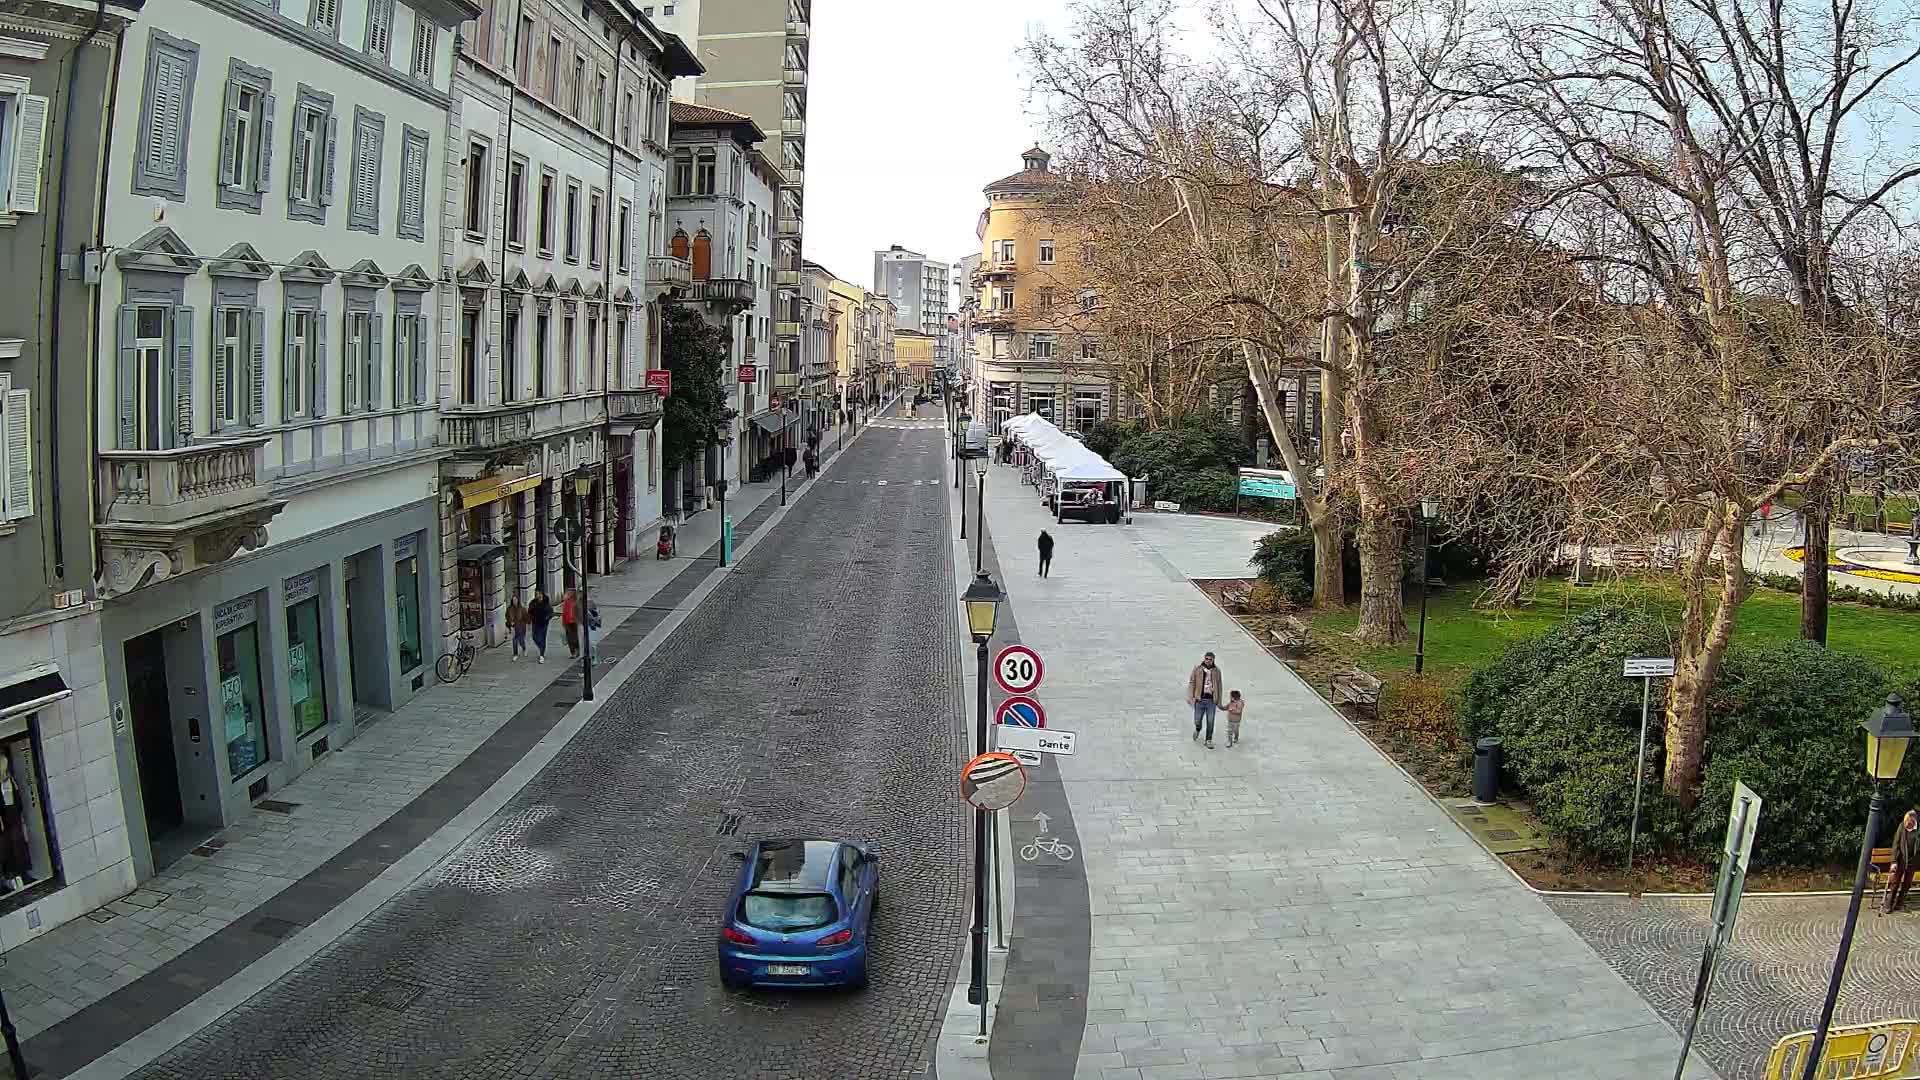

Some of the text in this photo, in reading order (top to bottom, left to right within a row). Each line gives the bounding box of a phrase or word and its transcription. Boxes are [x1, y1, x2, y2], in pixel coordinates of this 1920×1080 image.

[1006, 659, 1033, 681] 30
[223, 678, 241, 701] 130
[1039, 738, 1070, 751] Dante
